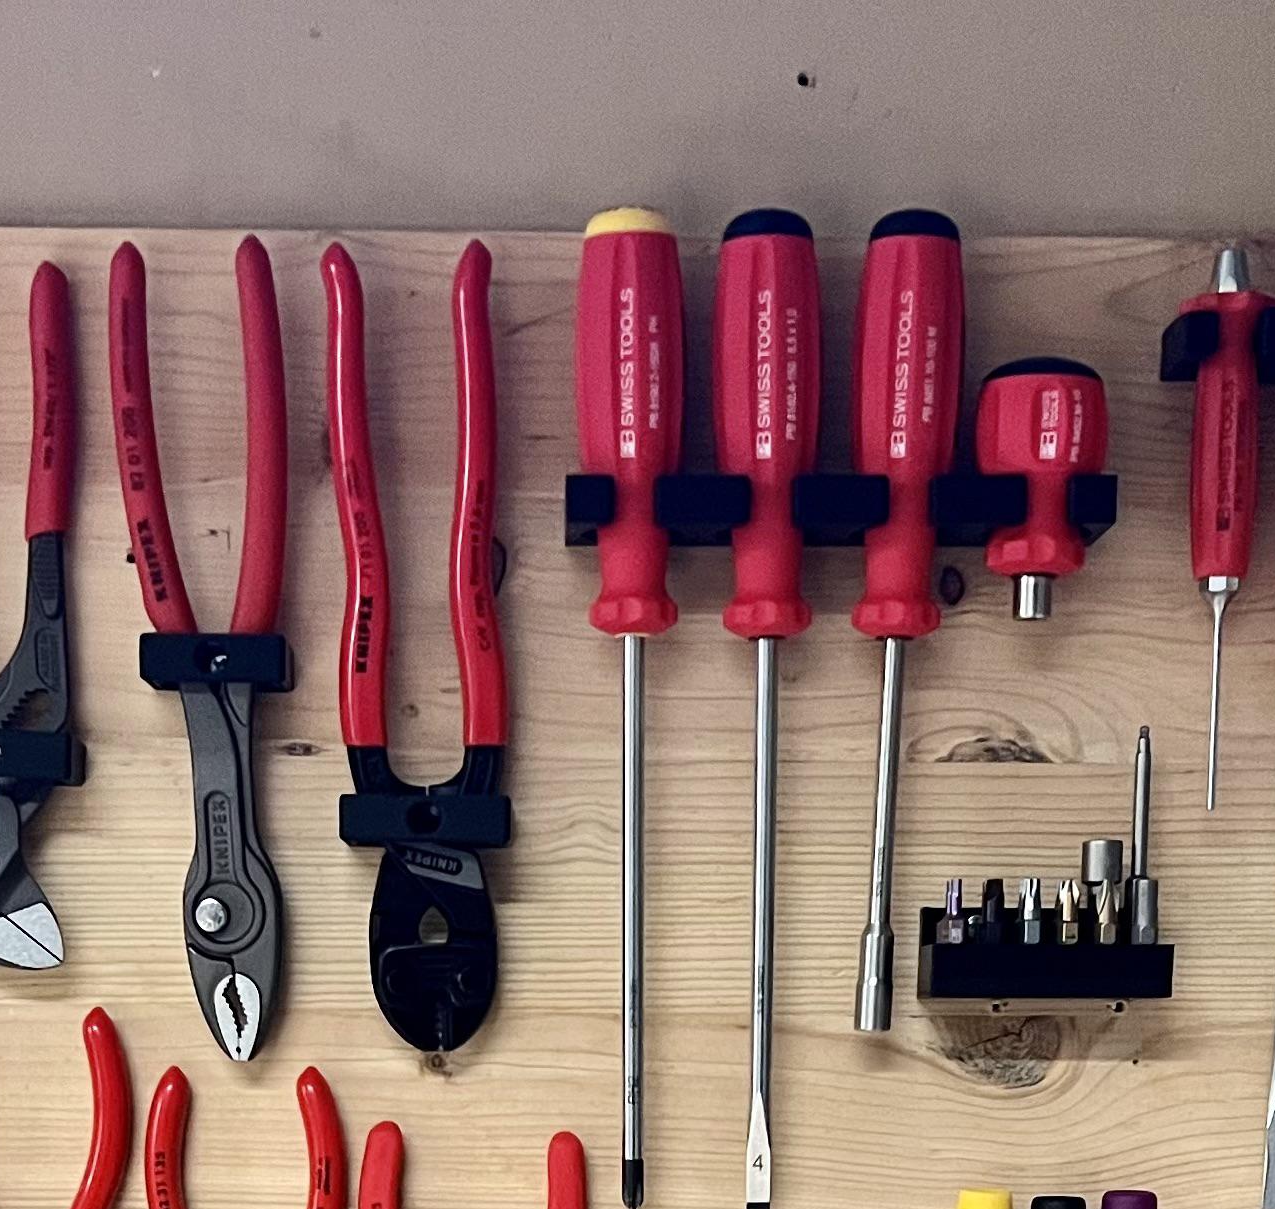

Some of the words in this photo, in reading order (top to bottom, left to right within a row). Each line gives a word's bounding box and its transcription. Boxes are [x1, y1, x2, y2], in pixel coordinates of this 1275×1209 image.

[620, 288, 634, 359] TOOLS
[757, 290, 771, 361] TOOLS
[897, 290, 914, 361] TOOLS
[620, 361, 634, 427] SWISS
[757, 362, 771, 428] SWISS
[892, 363, 908, 428] SWISS
[136, 519, 169, 602] KNIPEX
[355, 595, 374, 674] KNIPEX
[210, 799, 231, 877] KNIPEX
[406, 849, 458, 872] KNIPEX
[752, 1153, 764, 1172] 4
